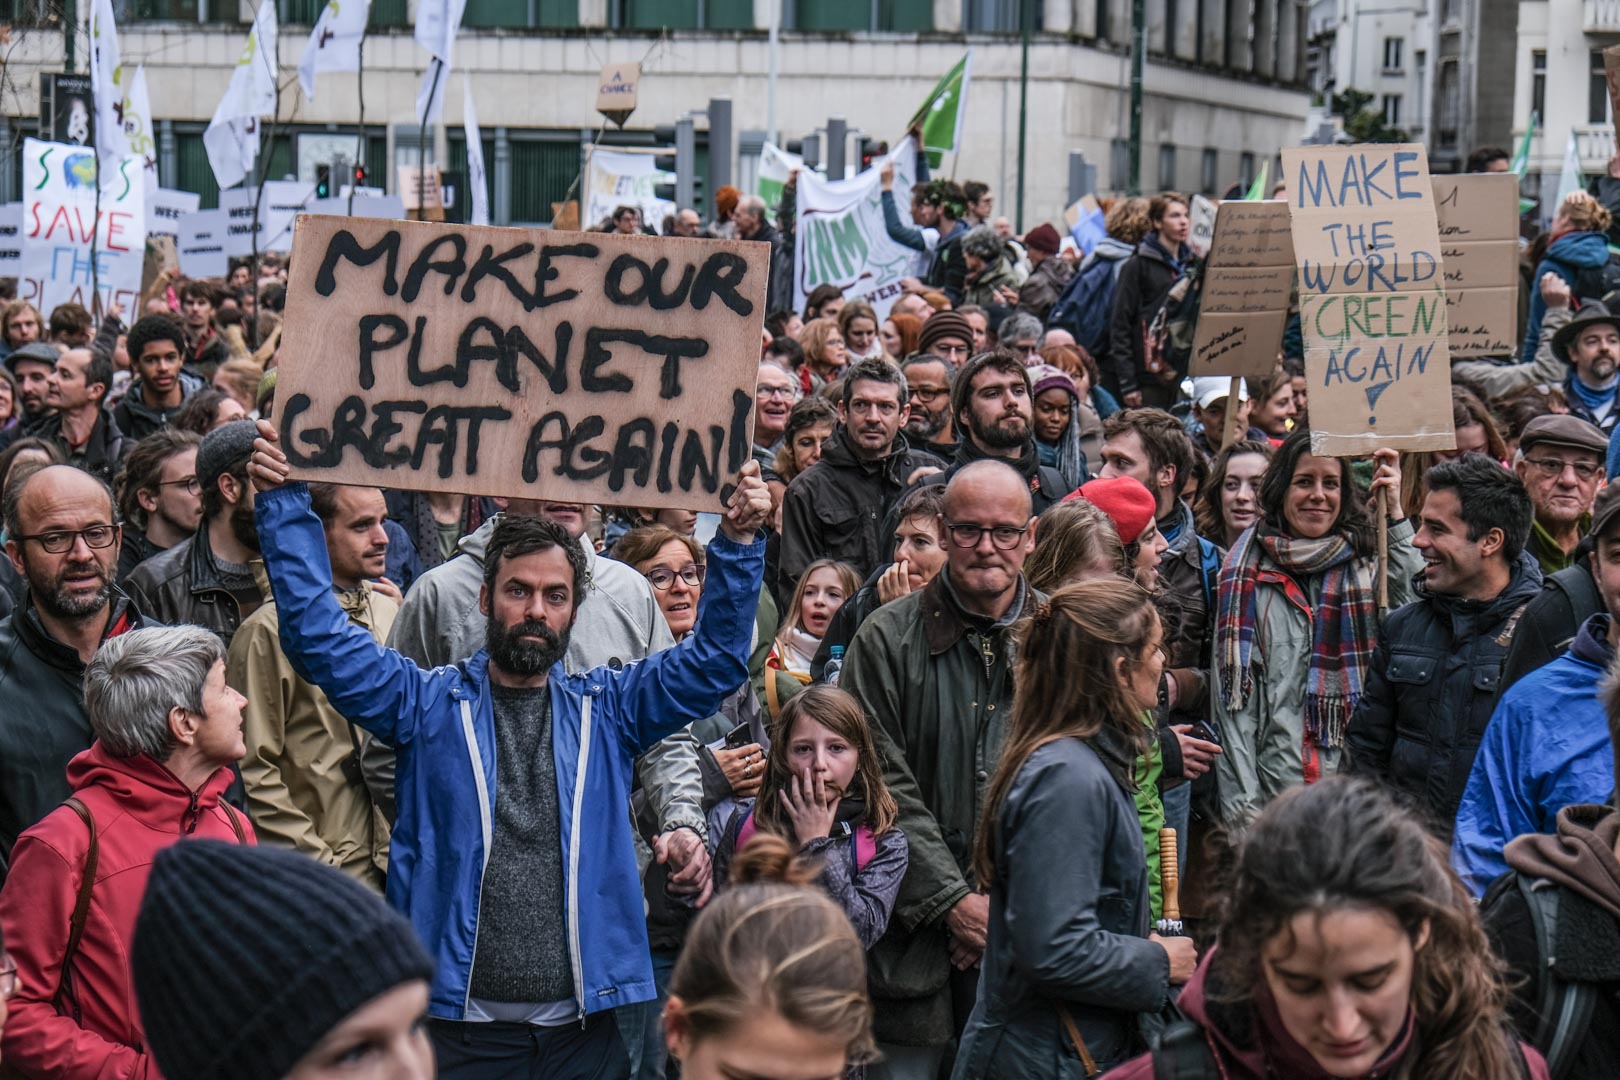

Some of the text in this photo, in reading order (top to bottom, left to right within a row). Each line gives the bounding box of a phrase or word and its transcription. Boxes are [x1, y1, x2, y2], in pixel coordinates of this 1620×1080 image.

[1299, 152, 1423, 208] MAKE
[29, 201, 133, 252] SAVE
[1322, 221, 1396, 257] THE
[52, 247, 121, 285] THE
[314, 229, 754, 318] MAKE OUR
[1303, 251, 1437, 294] WORLD
[1315, 295, 1438, 354] GREEN
[357, 313, 710, 399] PLANET
[1365, 380, 1394, 426] !
[279, 388, 754, 508] GREAT AGAIN!
